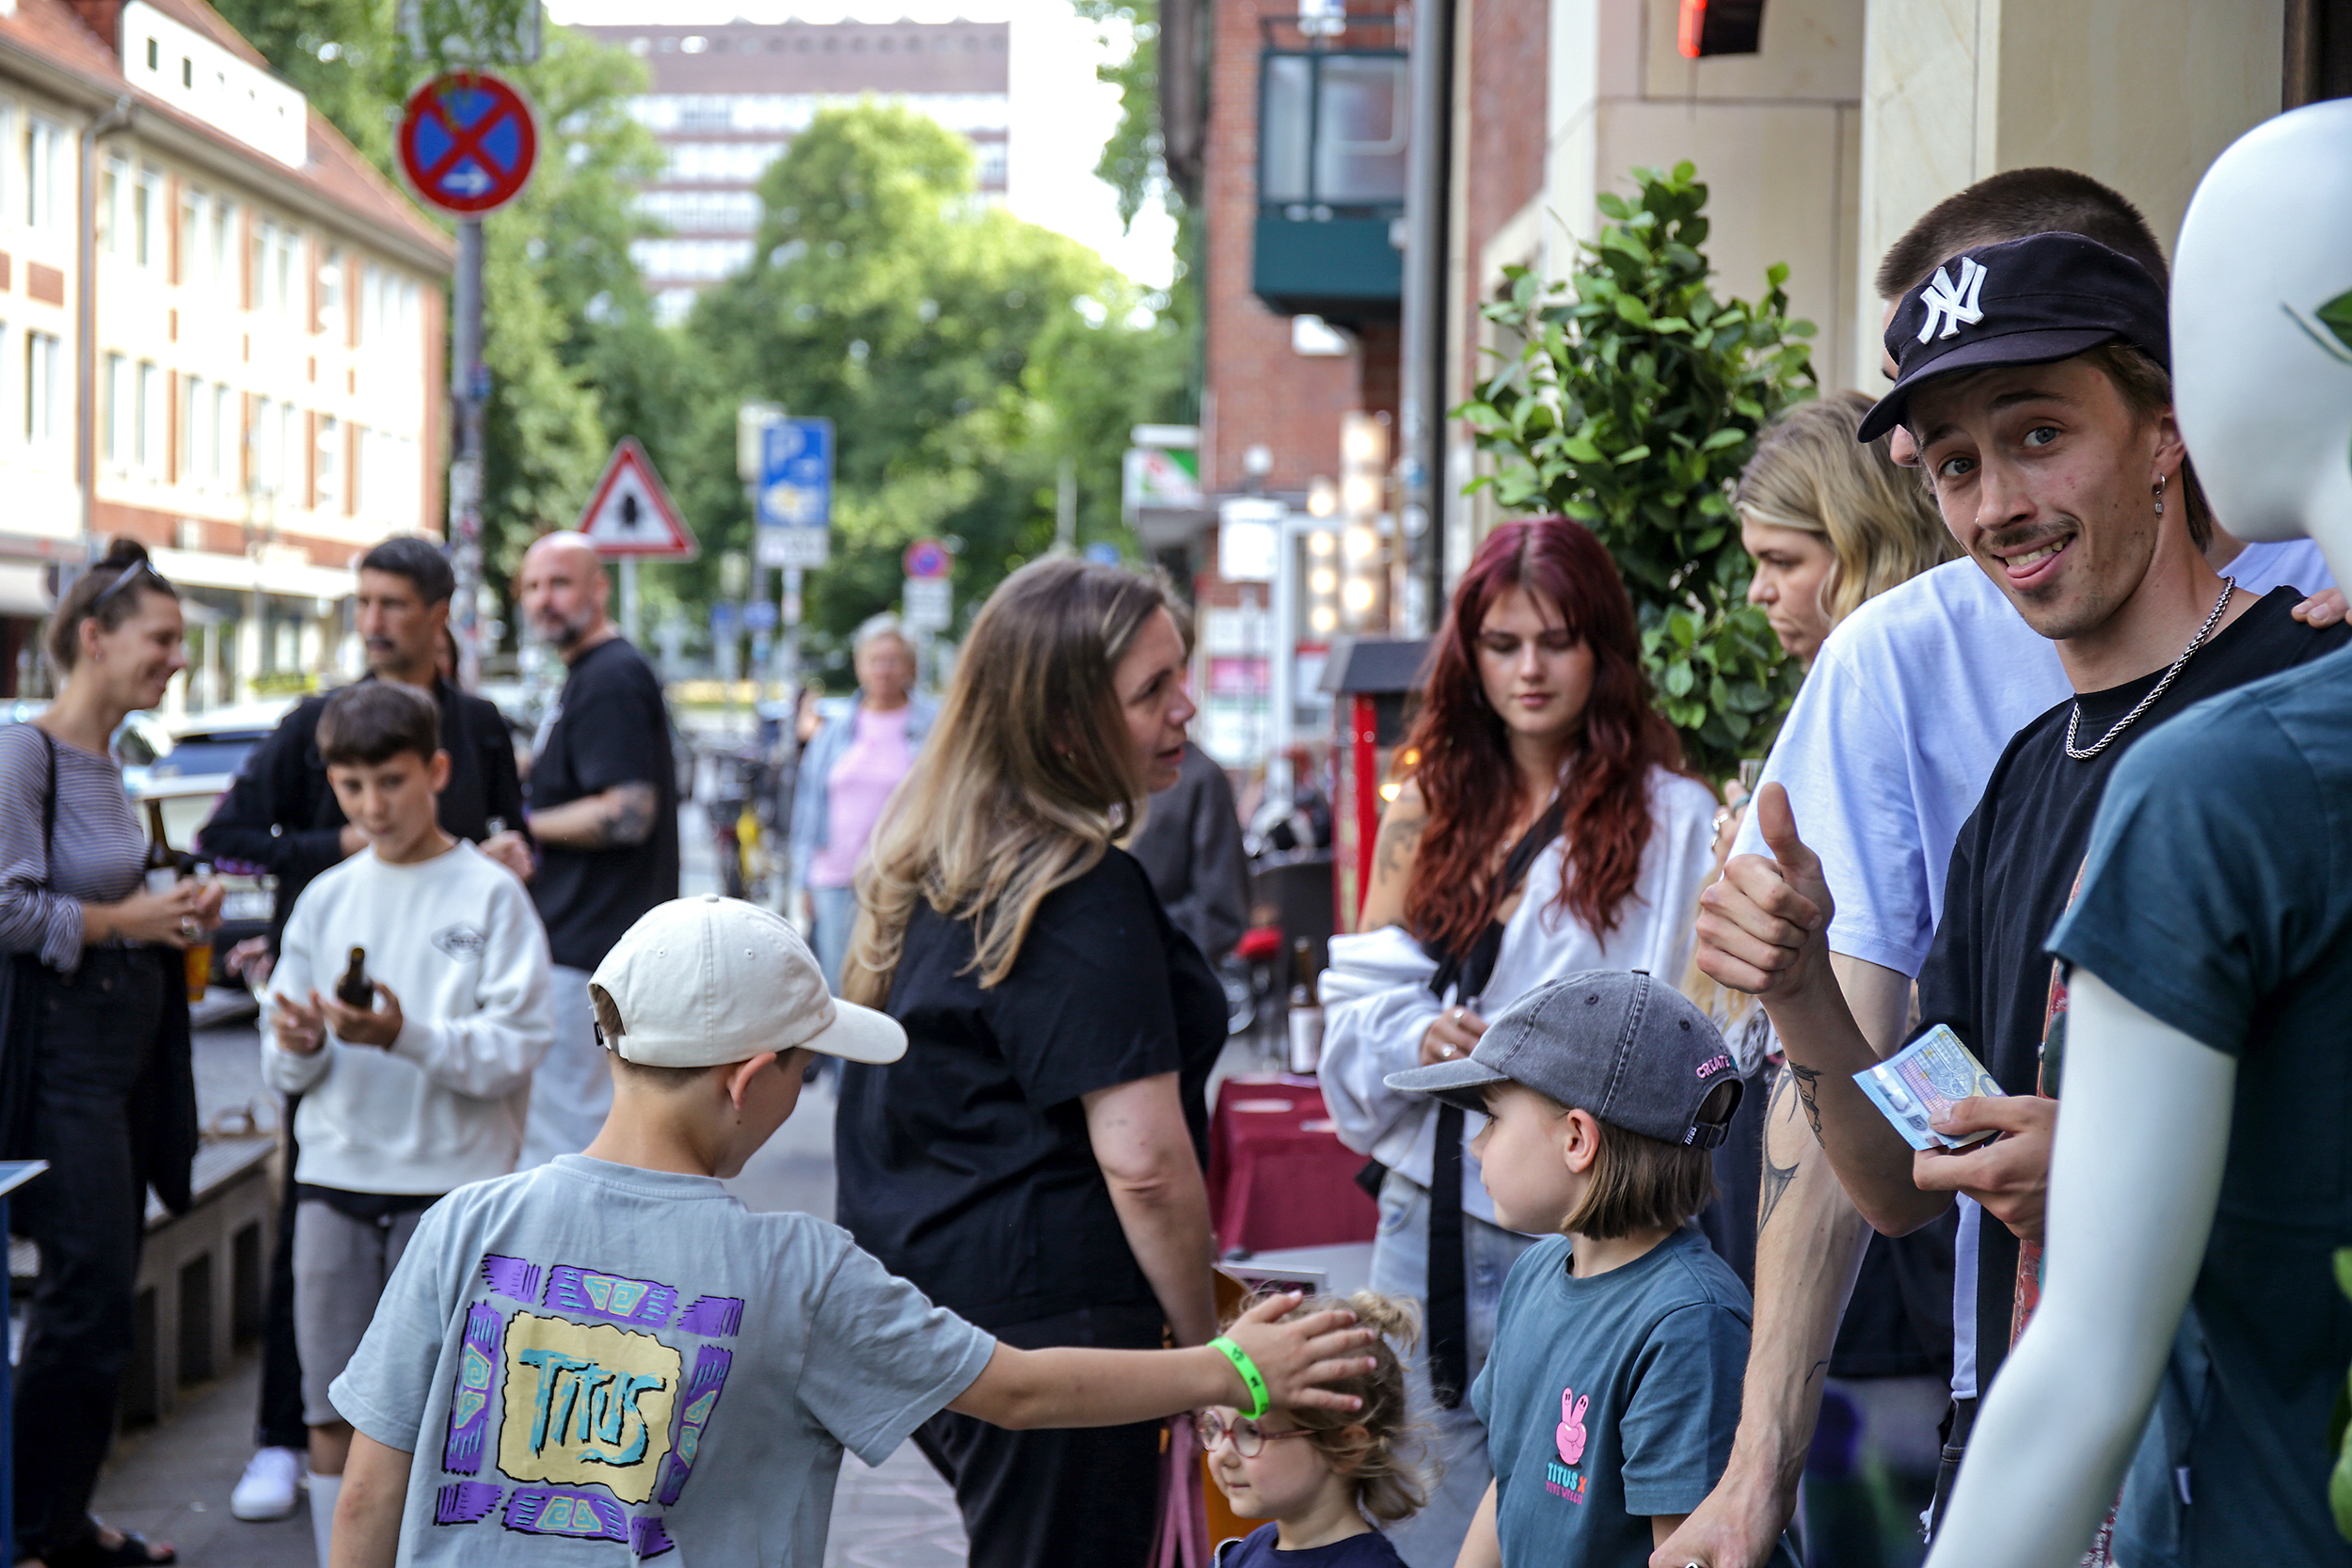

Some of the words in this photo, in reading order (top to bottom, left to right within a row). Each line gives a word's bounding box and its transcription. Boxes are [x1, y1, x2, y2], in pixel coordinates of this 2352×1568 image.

[1917, 256, 1988, 344] NY
[1696, 1054, 1730, 1079] CREATE
[1684, 1126, 1697, 1146] TITUS
[1548, 1462, 1579, 1491] TITUS
